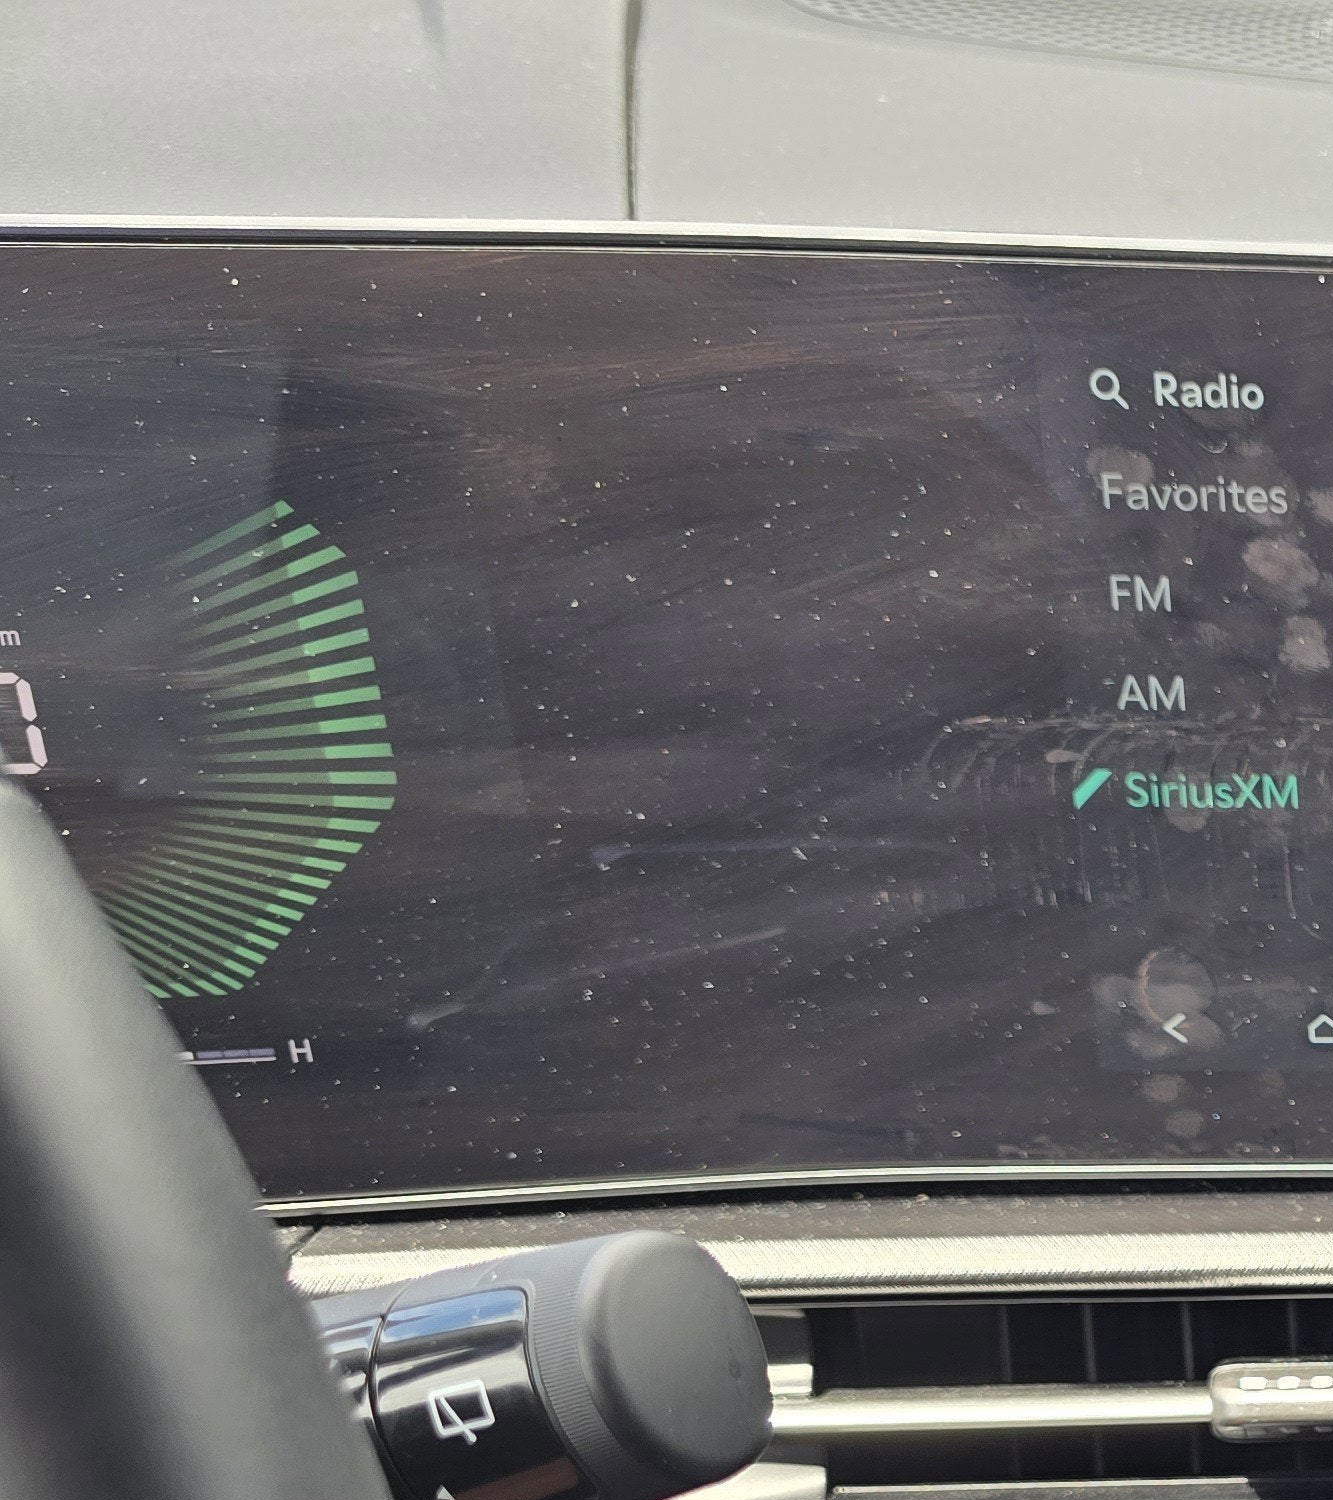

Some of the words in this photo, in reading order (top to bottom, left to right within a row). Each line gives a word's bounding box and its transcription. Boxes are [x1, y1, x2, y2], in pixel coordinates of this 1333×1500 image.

[1153, 370, 1264, 410] Radio
[1101, 471, 1288, 515] Favorites
[1109, 574, 1172, 612] FM
[1117, 675, 1187, 711] AM
[1125, 772, 1299, 812] SiriusXM
[288, 1038, 314, 1064] H
